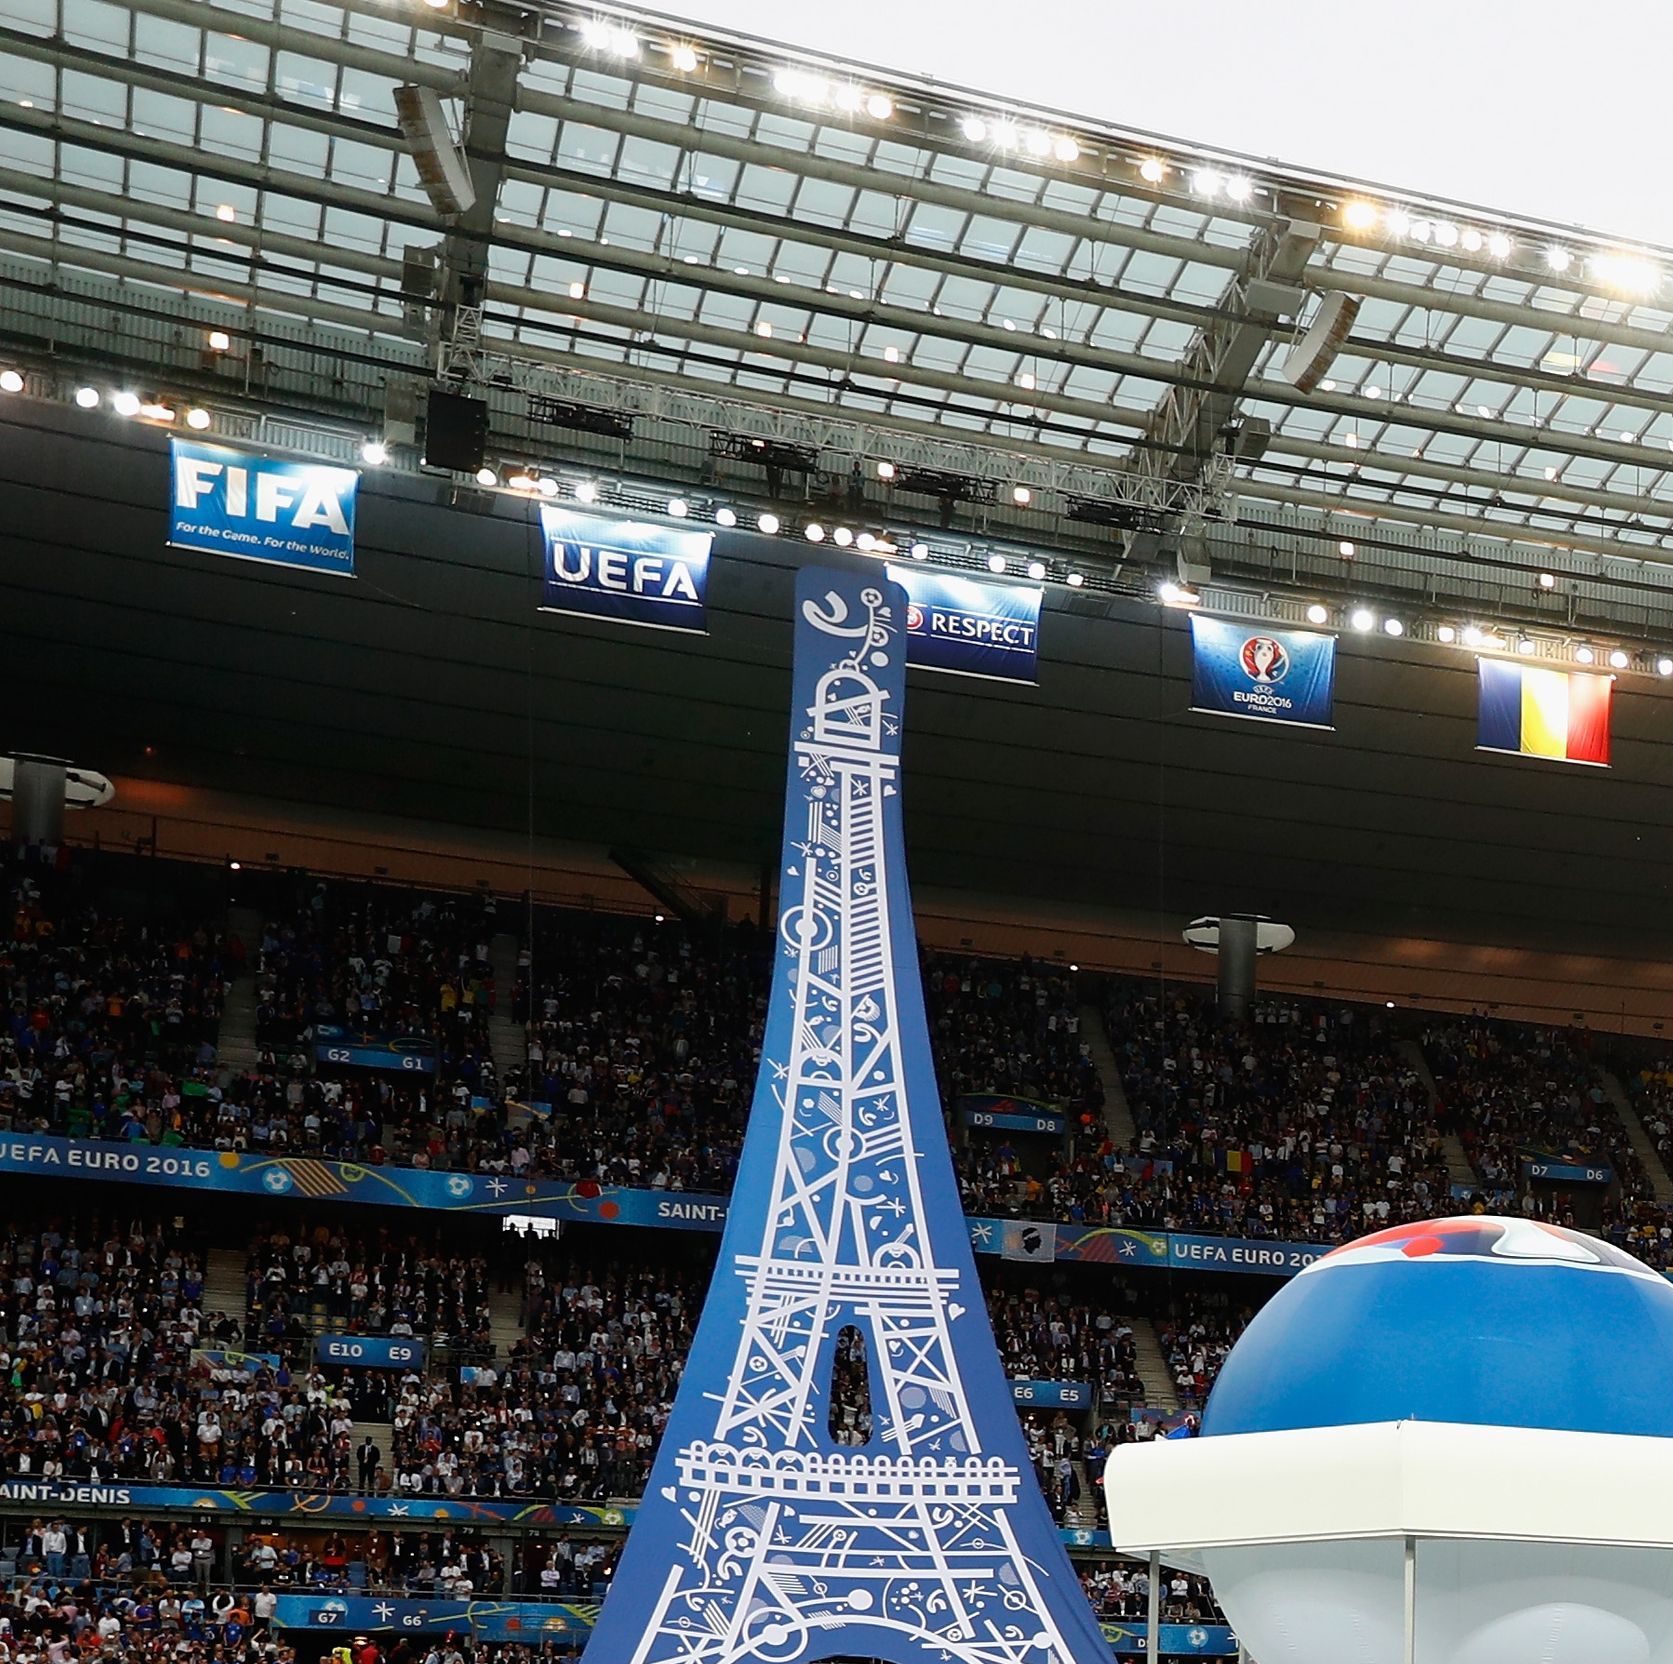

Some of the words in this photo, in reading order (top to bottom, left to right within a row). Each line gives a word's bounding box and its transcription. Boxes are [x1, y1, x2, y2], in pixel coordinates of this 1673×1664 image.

[177, 456, 350, 535] FIFA
[176, 521, 199, 533] For
[199, 524, 220, 537] the
[222, 527, 261, 544] Game.
[264, 535, 283, 548] For
[283, 539, 305, 552] the
[310, 544, 350, 560] World.
[554, 543, 699, 600] UEFA
[932, 612, 1034, 645] RESPECT
[1233, 691, 1292, 709] EURO2016
[1247, 704, 1277, 714] FRANCE
[328, 1049, 350, 1062] G2
[403, 1058, 423, 1070] G1
[974, 1113, 993, 1126] D9
[1036, 1119, 1056, 1132] D8
[68, 1149, 139, 1171] EURO
[146, 1157, 210, 1177] 2016
[1532, 1165, 1548, 1177] D7
[1586, 1168, 1604, 1181] D6
[658, 1202, 725, 1221] SAINT-
[1175, 1244, 1228, 1262] UEFA
[1232, 1247, 1285, 1266] EURO
[329, 1343, 362, 1358] E10
[389, 1347, 412, 1361] E9
[1014, 1387, 1033, 1400] E6
[1060, 1389, 1080, 1402] E5
[0, 1484, 130, 1505] AINT-DENIS
[462, 1527, 474, 1535] 79
[318, 1613, 338, 1623] G7
[403, 1616, 422, 1626] G6
